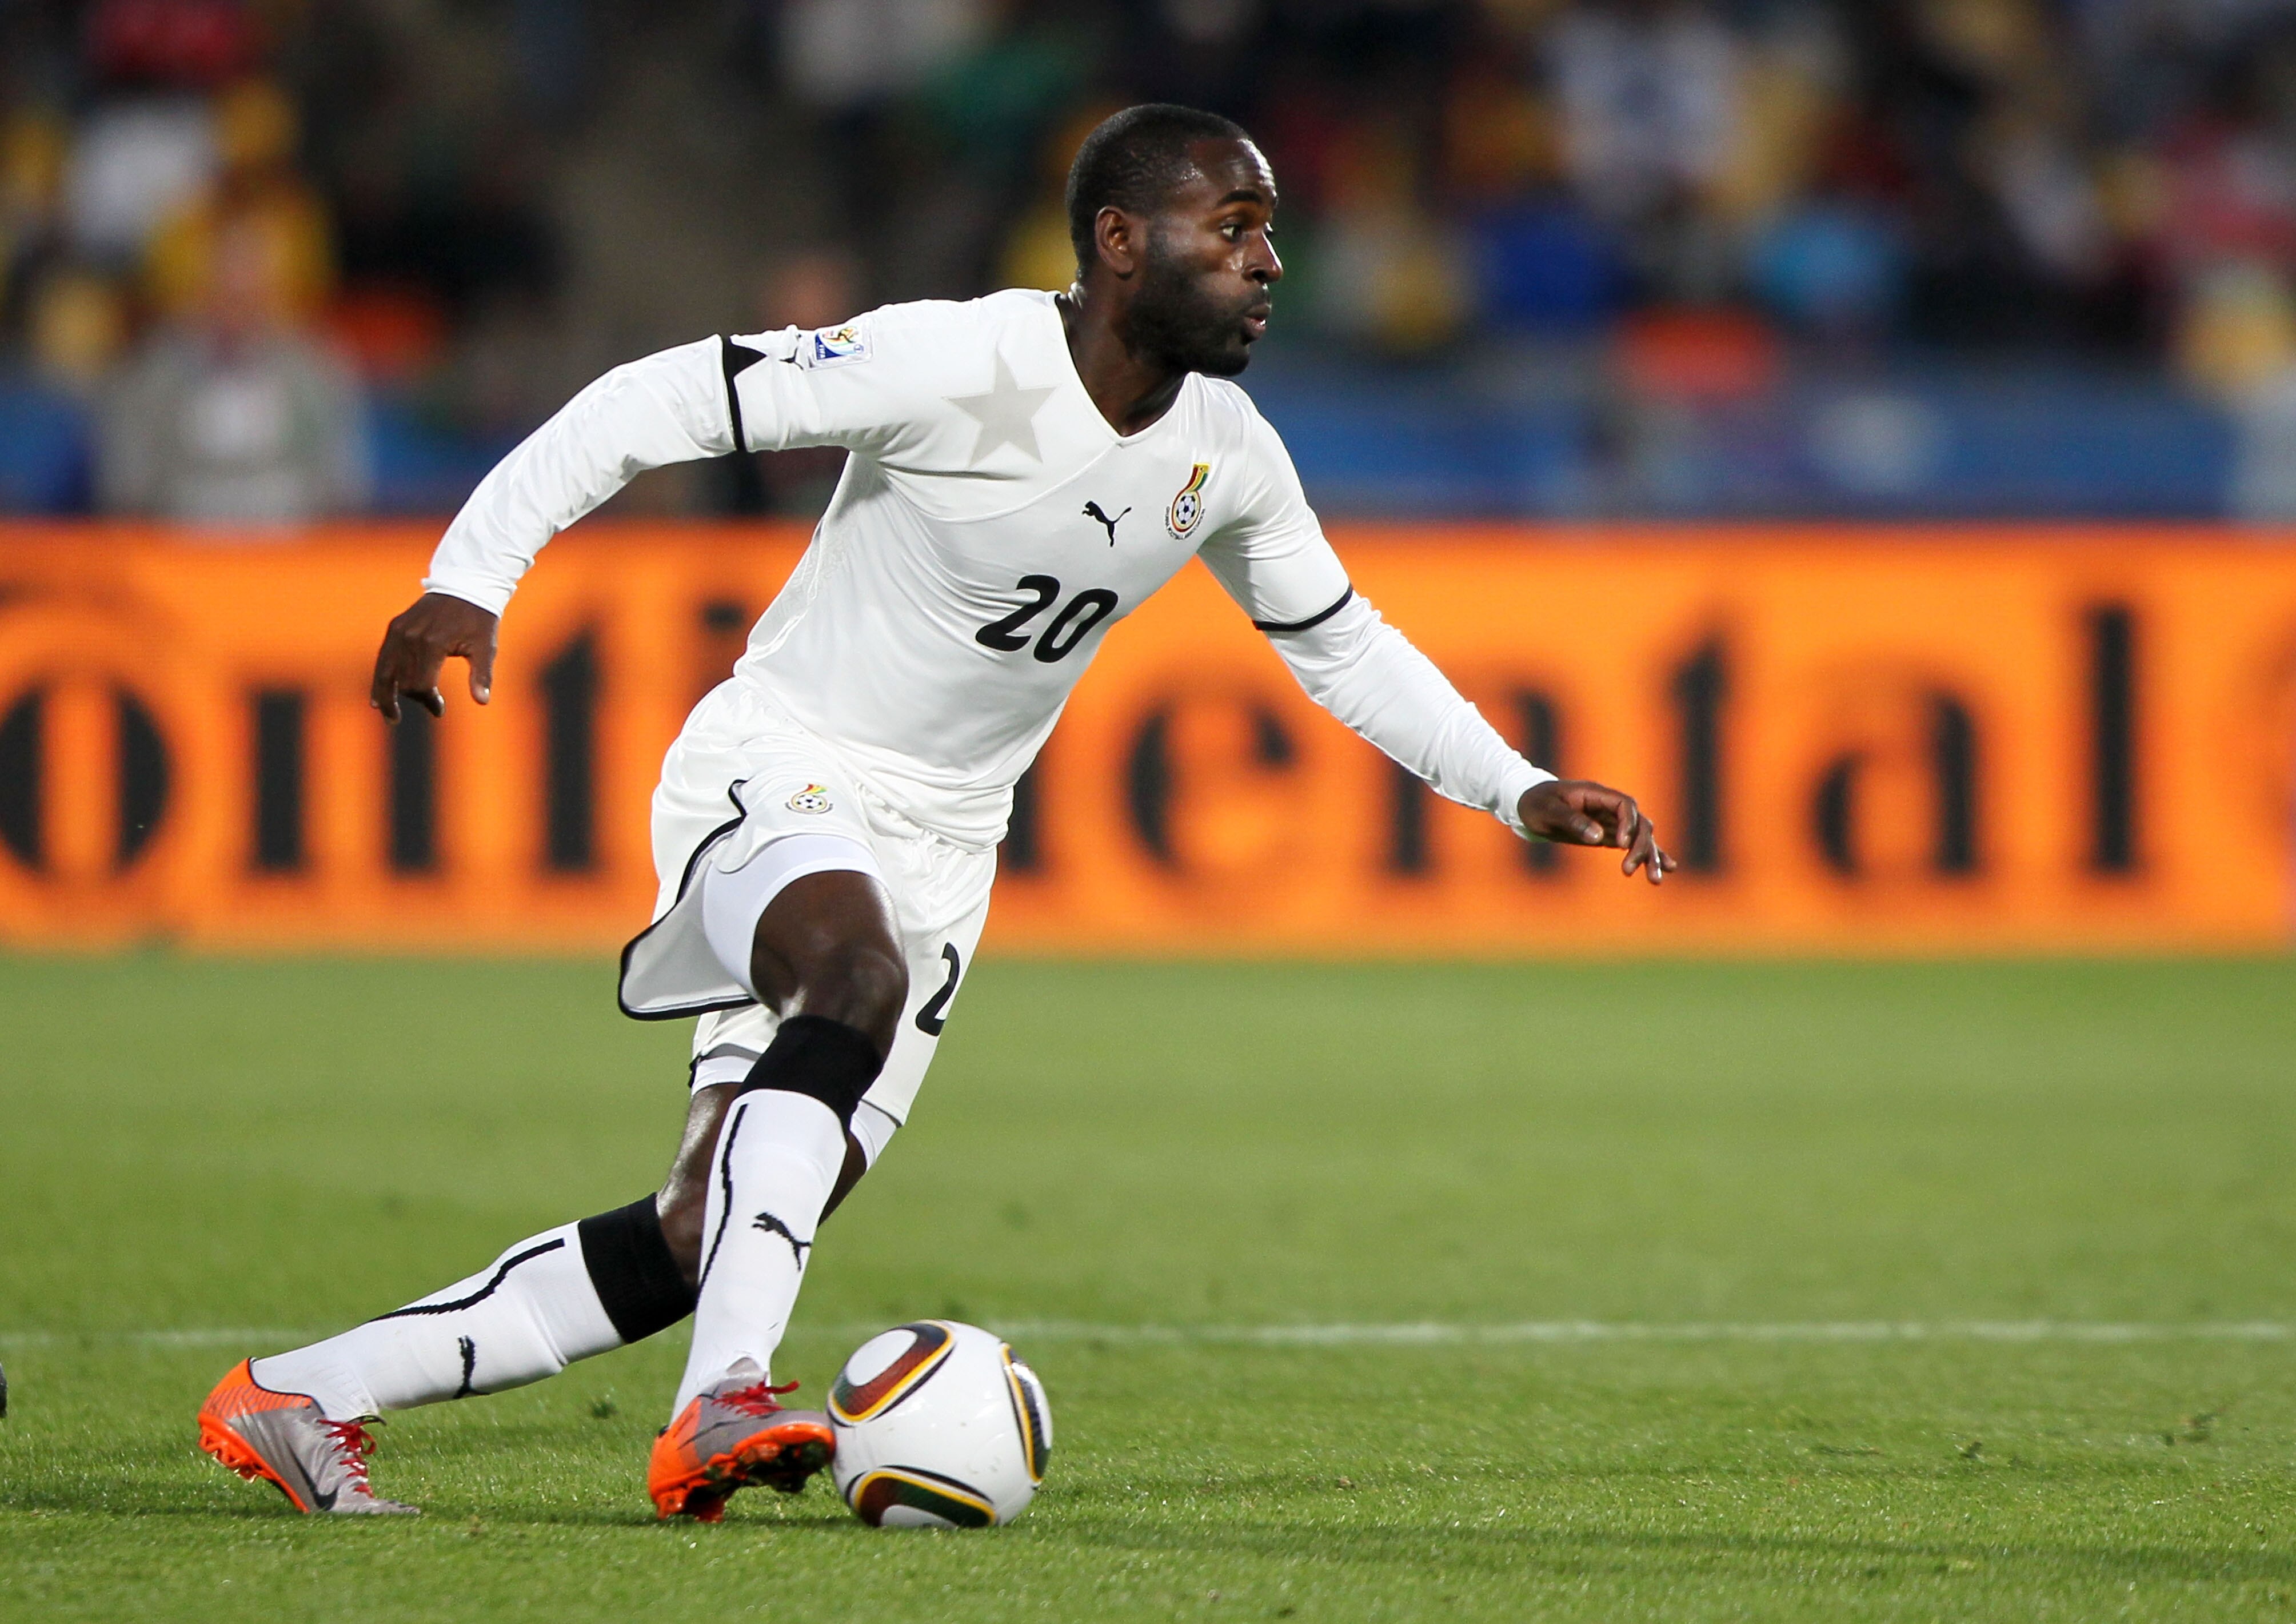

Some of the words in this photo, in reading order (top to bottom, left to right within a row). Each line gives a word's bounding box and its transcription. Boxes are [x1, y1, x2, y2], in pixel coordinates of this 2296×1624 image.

[975, 574, 1119, 663] 20
[0, 592, 2149, 880] ontental
[915, 942, 960, 1037] 2
